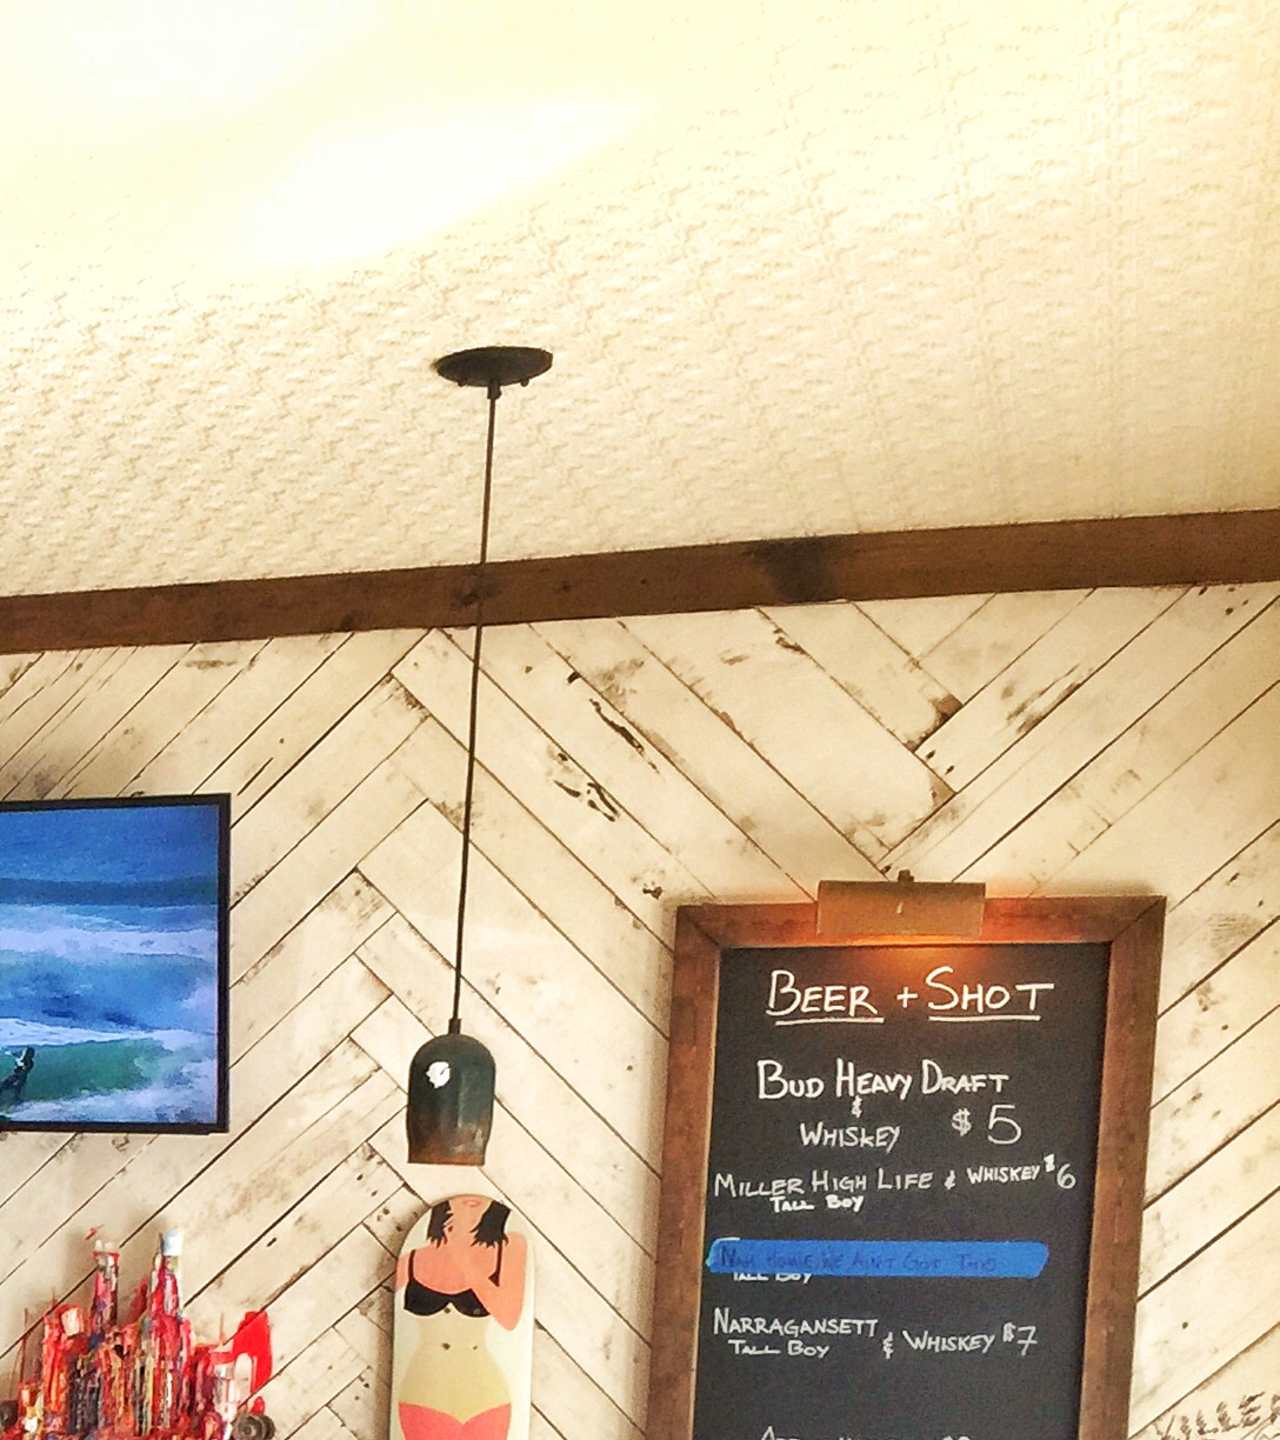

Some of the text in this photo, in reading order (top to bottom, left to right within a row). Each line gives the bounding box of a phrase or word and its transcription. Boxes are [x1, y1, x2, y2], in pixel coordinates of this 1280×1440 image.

[765, 965, 1056, 1016] BEER + SHOT
[756, 1057, 1009, 1100] BUD HEAVY DRAFT
[800, 1121, 901, 1151] WHISKEY
[714, 1171, 804, 1200] MILLER
[811, 1168, 868, 1194] HIGH
[877, 1165, 934, 1192] LIFE
[965, 1162, 1041, 1187] WHISKEY
[770, 1194, 865, 1215] TALL BOY
[713, 1306, 879, 1338] NARRAGANSETT
[903, 1328, 996, 1355] WHISKEY
[728, 1339, 830, 1361] TALL BOY
